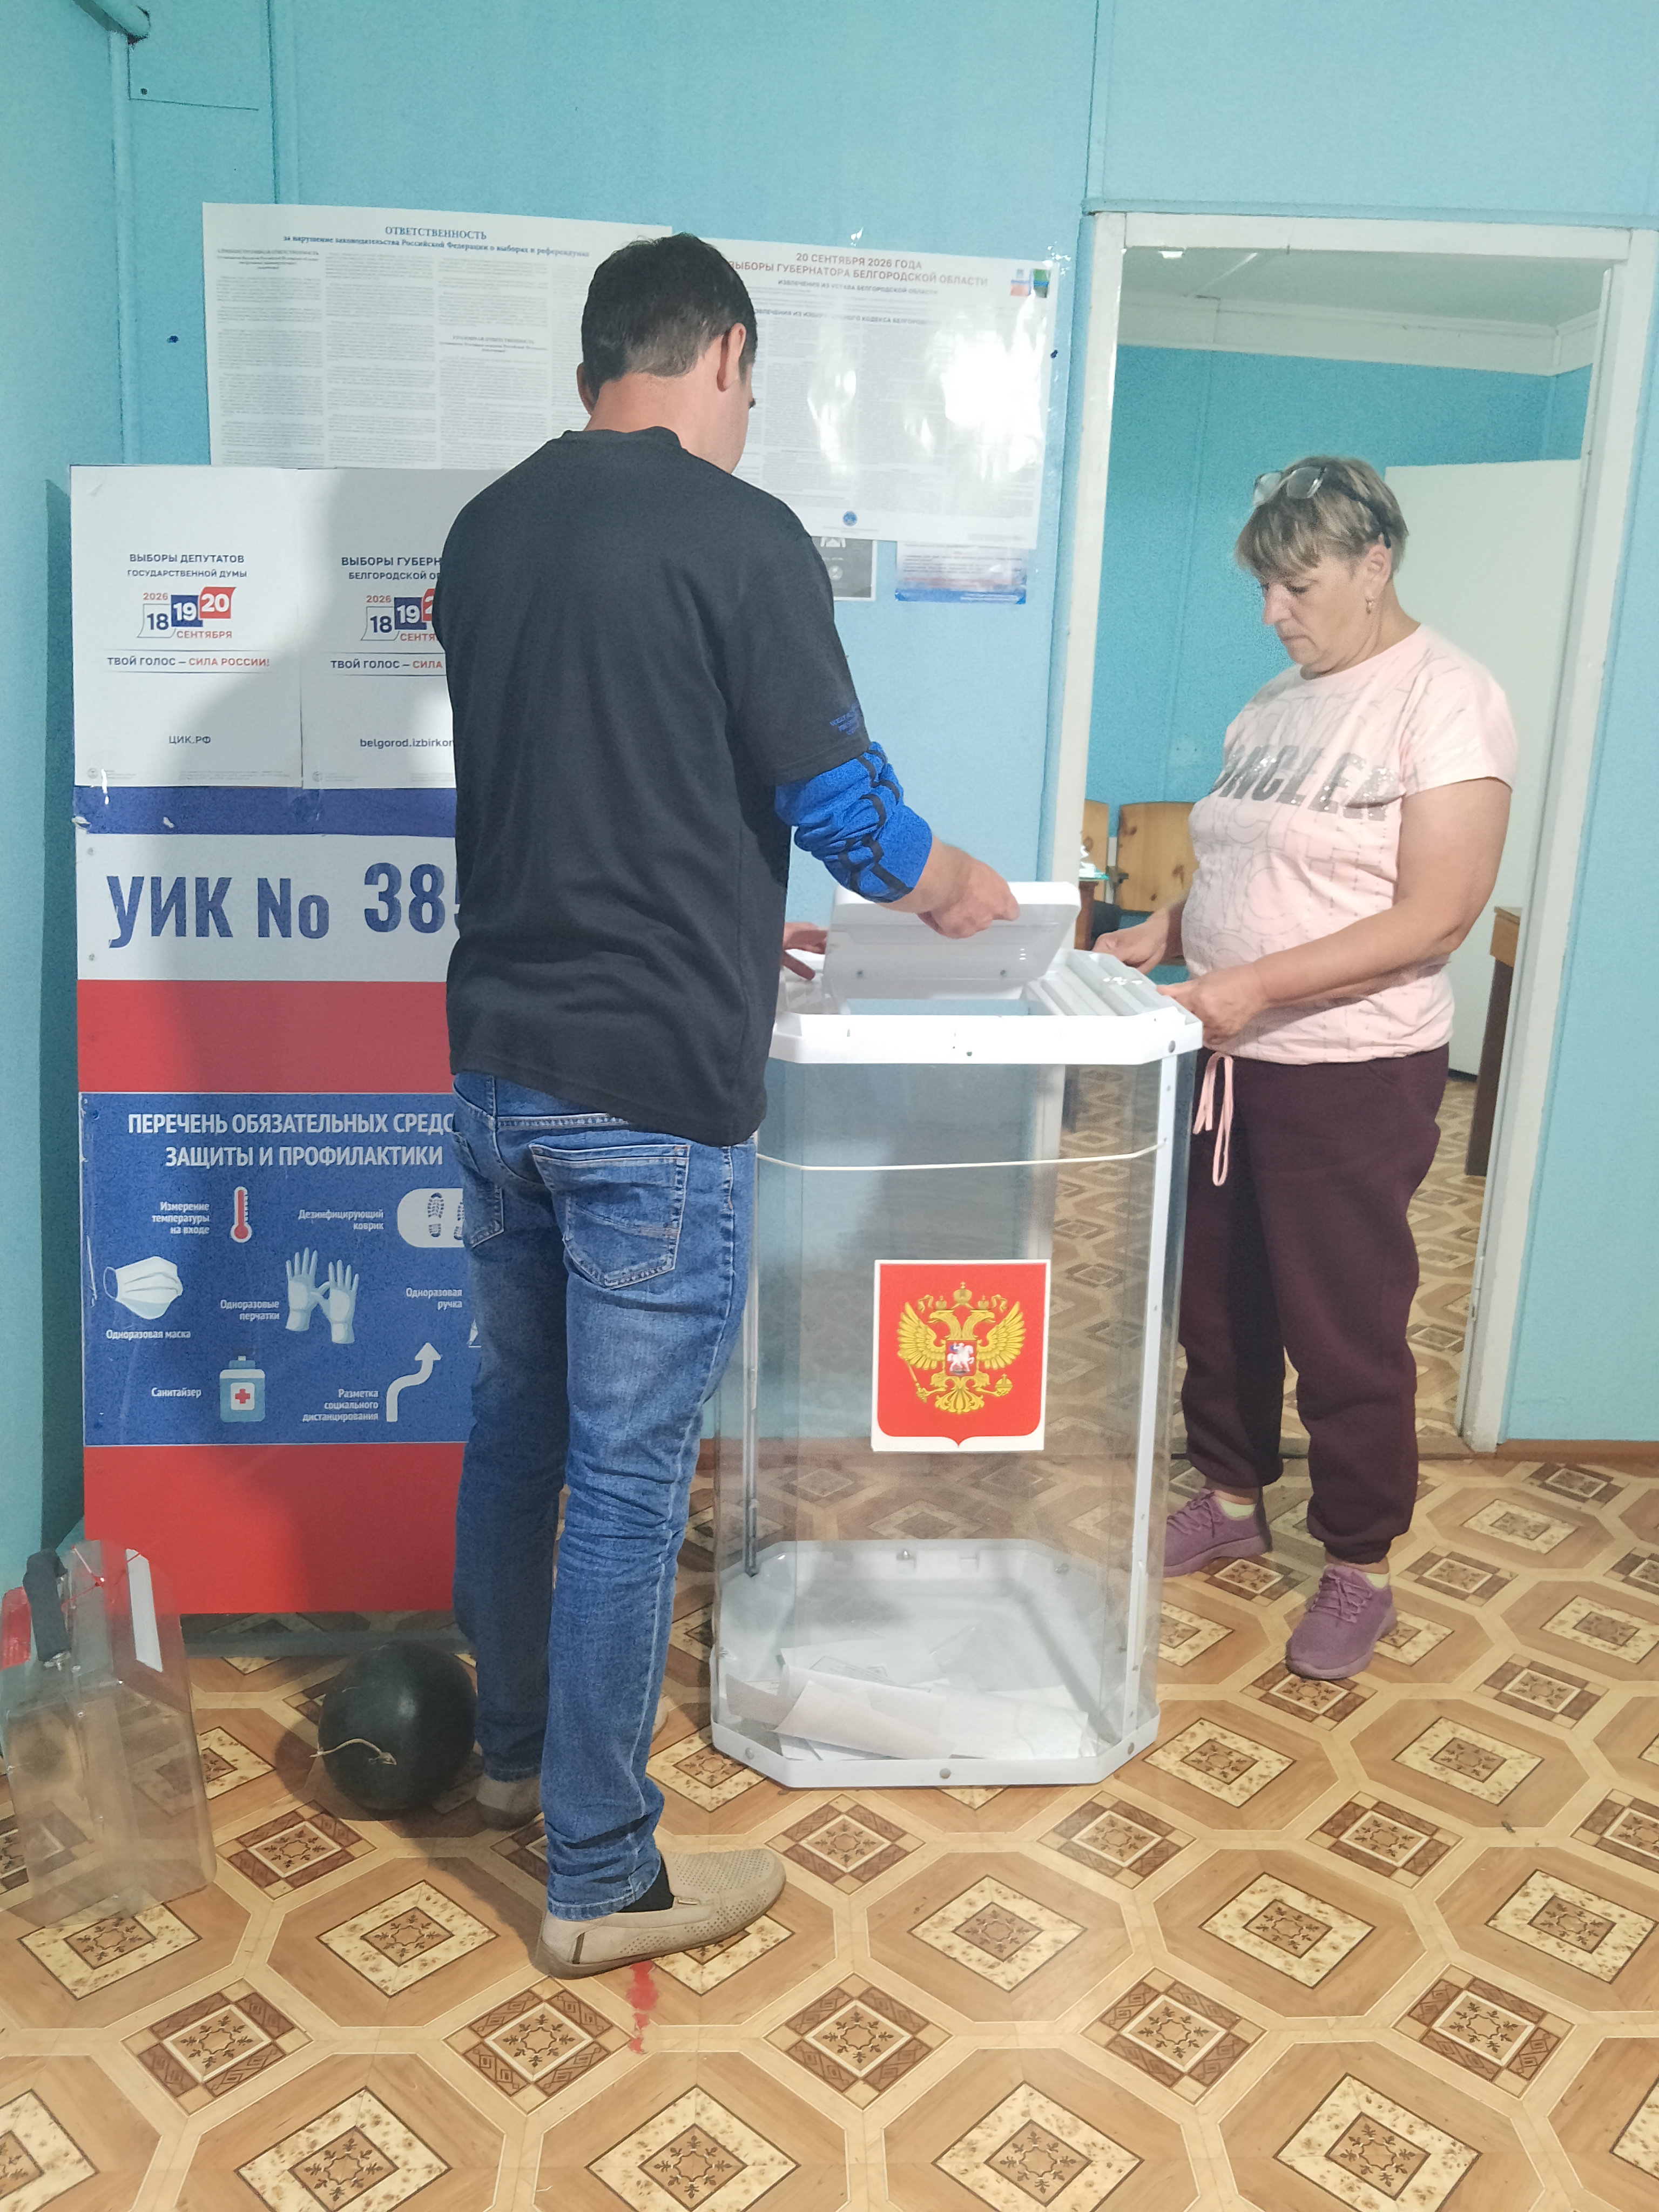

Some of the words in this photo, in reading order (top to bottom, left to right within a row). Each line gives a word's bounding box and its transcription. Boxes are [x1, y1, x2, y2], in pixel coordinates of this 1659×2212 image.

[385, 226, 486, 239] ОТВЕТСТВЕННОСТЬ
[401, 239, 444, 248] Российской
[446, 241, 489, 251] Федерации
[496, 245, 529, 254] выборах
[796, 253, 808, 262] 20
[811, 254, 865, 267] СЕНТЯБРЯ
[867, 257, 892, 267] 2026
[894, 259, 922, 270] ГОДА
[777, 264, 851, 278] ГУБЕРНАТОРА
[853, 268, 937, 284] БЕЛГОРОДСКОЙ
[939, 274, 988, 287] ОБЛАСТИ
[129, 554, 178, 563] ВЫБОРЫ
[180, 555, 245, 563] ДЕПУТАТОВ
[341, 556, 394, 566] ВЫБОРЫ
[127, 569, 217, 578] ГОСУДАРСТВЕННОЙ
[348, 570, 427, 581] БЕЛГОРОДСКОЙ
[143, 592, 168, 601] 2026
[366, 595, 392, 603] 2026
[146, 613, 169, 631] 18
[173, 602, 197, 621] 19
[201, 593, 230, 613] 20
[370, 615, 393, 633] 18
[396, 604, 421, 624] 19
[176, 630, 232, 639] СЕНТЯБРЯ
[107, 655, 137, 666] ТВОЙ
[139, 658, 176, 666] ГОЛОС
[188, 658, 217, 666] СИЛА
[220, 658, 270, 667] РОССИИ!
[330, 658, 361, 669] ТВОЙ
[363, 660, 401, 669] ГОЛОС
[412, 660, 443, 669] СИЛА
[168, 736, 211, 745] ЦИК.РФ
[105, 875, 234, 949] УИК
[363, 862, 460, 934] 38
[128, 1113, 228, 1134] ПЕРЕЧЕНЬ
[232, 1113, 388, 1134] ОБЯЗАТЕЛЬНЫХ
[165, 1146, 253, 1169] ЗАЩИТЫ
[259, 1147, 273, 1166] И
[279, 1145, 443, 1166] ПРОФИЛАКТИКИ
[159, 1202, 210, 1212] Измерение
[151, 1215, 210, 1225] температуры
[298, 1209, 384, 1221] Дезинфицирующий
[170, 1226, 181, 1235] на
[183, 1226, 210, 1235] входе
[353, 1223, 384, 1232] коврик
[406, 1287, 463, 1299] Одноразовая
[220, 1299, 279, 1310] Одноразовые
[437, 1300, 463, 1310] ручка
[239, 1312, 280, 1321] перчатки
[105, 1329, 164, 1341] Одноразовая
[165, 1330, 191, 1338] маска
[151, 1387, 201, 1398] Санитайзер
[338, 1388, 379, 1398] Разметка
[324, 1401, 379, 1410] социального
[302, 1413, 379, 1422] дистанцирования
